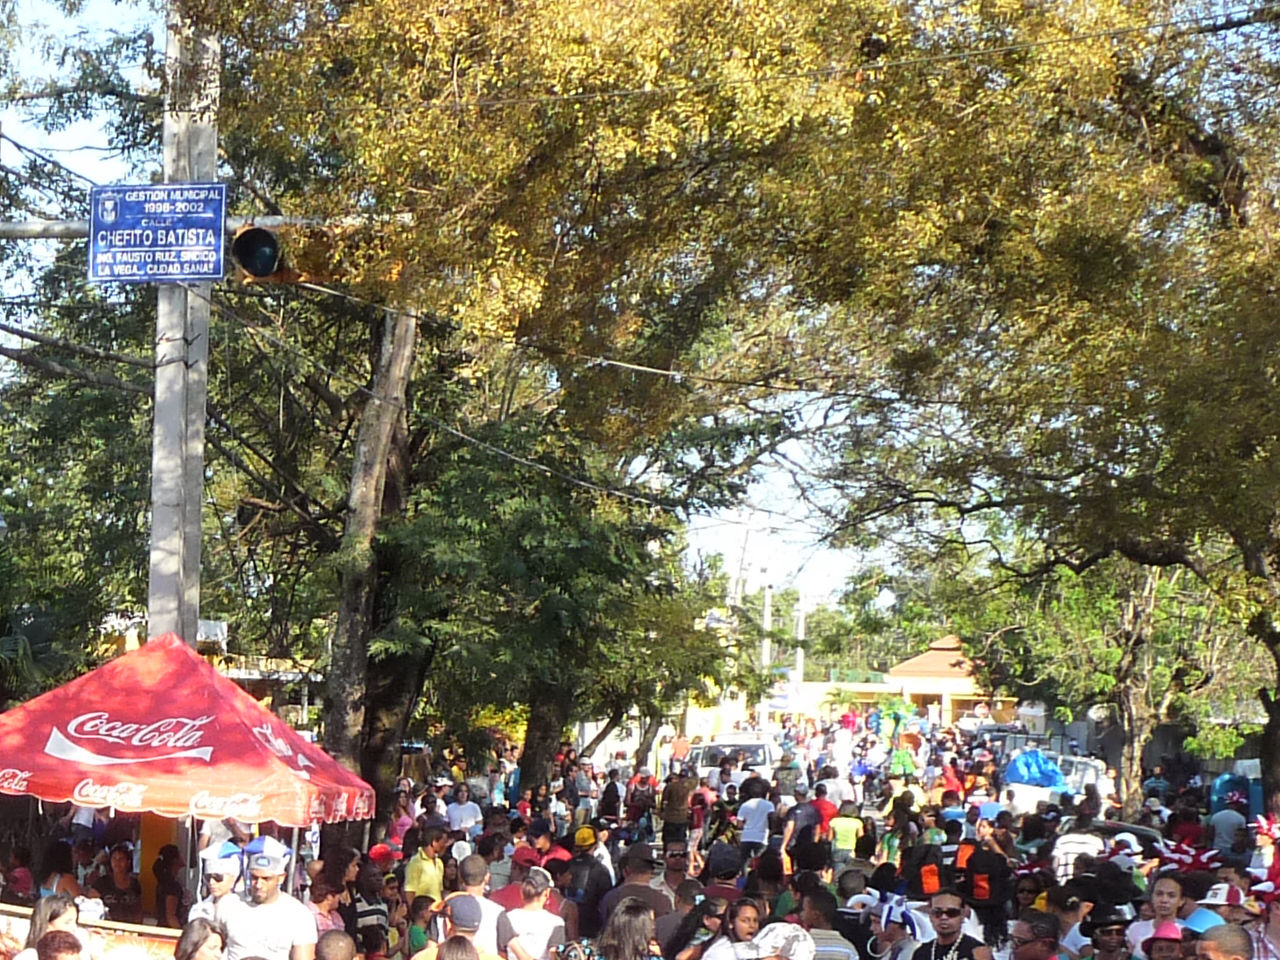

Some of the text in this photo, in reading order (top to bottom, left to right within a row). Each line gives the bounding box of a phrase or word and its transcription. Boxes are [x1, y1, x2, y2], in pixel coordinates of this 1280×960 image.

[125, 189, 221, 201] GESTION MUNICIPAL
[143, 201, 204, 213] 1998-2002
[141, 218, 172, 227] CALLE
[97, 229, 215, 246] CHEFITO BATISTA
[116, 251, 153, 263] FAUSTO
[97, 264, 111, 276] LA
[146, 263, 181, 274] CIUDAD
[67, 711, 217, 747] Coca-Cola
